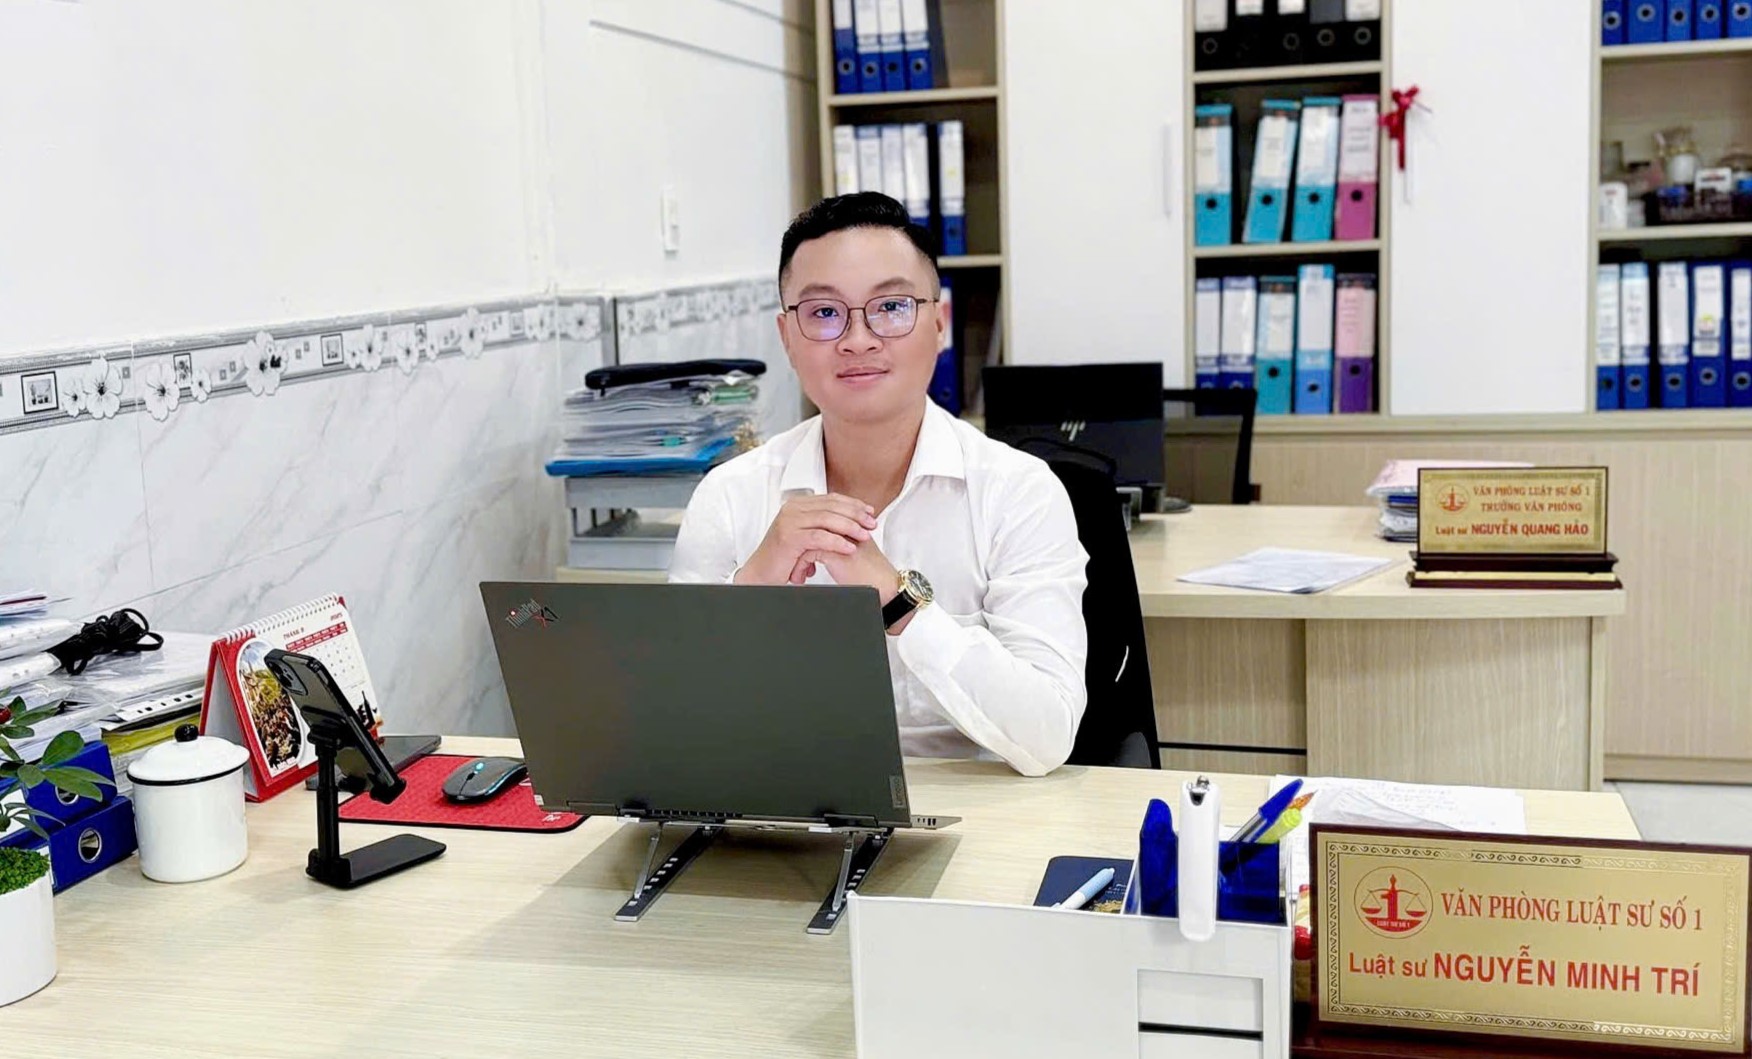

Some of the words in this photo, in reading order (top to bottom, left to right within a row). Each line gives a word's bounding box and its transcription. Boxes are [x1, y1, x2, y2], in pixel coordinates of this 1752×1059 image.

[1585, 486, 1590, 496] 1
[1471, 518, 1518, 535] NGUYỄN
[1521, 523, 1560, 536] QUANG
[1564, 519, 1588, 535] HẢO
[505, 598, 541, 628] ThinkPad
[1441, 887, 1483, 917] VĂN
[1488, 890, 1560, 922] PHÒNG
[1566, 895, 1621, 931] LUẬT
[1626, 899, 1655, 928] SƯ
[1660, 895, 1687, 929] SỐ
[1693, 908, 1702, 931] 1
[1349, 952, 1395, 979] Luật
[1402, 959, 1428, 978] sư
[1434, 944, 1556, 986] NGUYỄN
[1567, 961, 1640, 992] MINH
[1650, 962, 1701, 997] TRÍ
